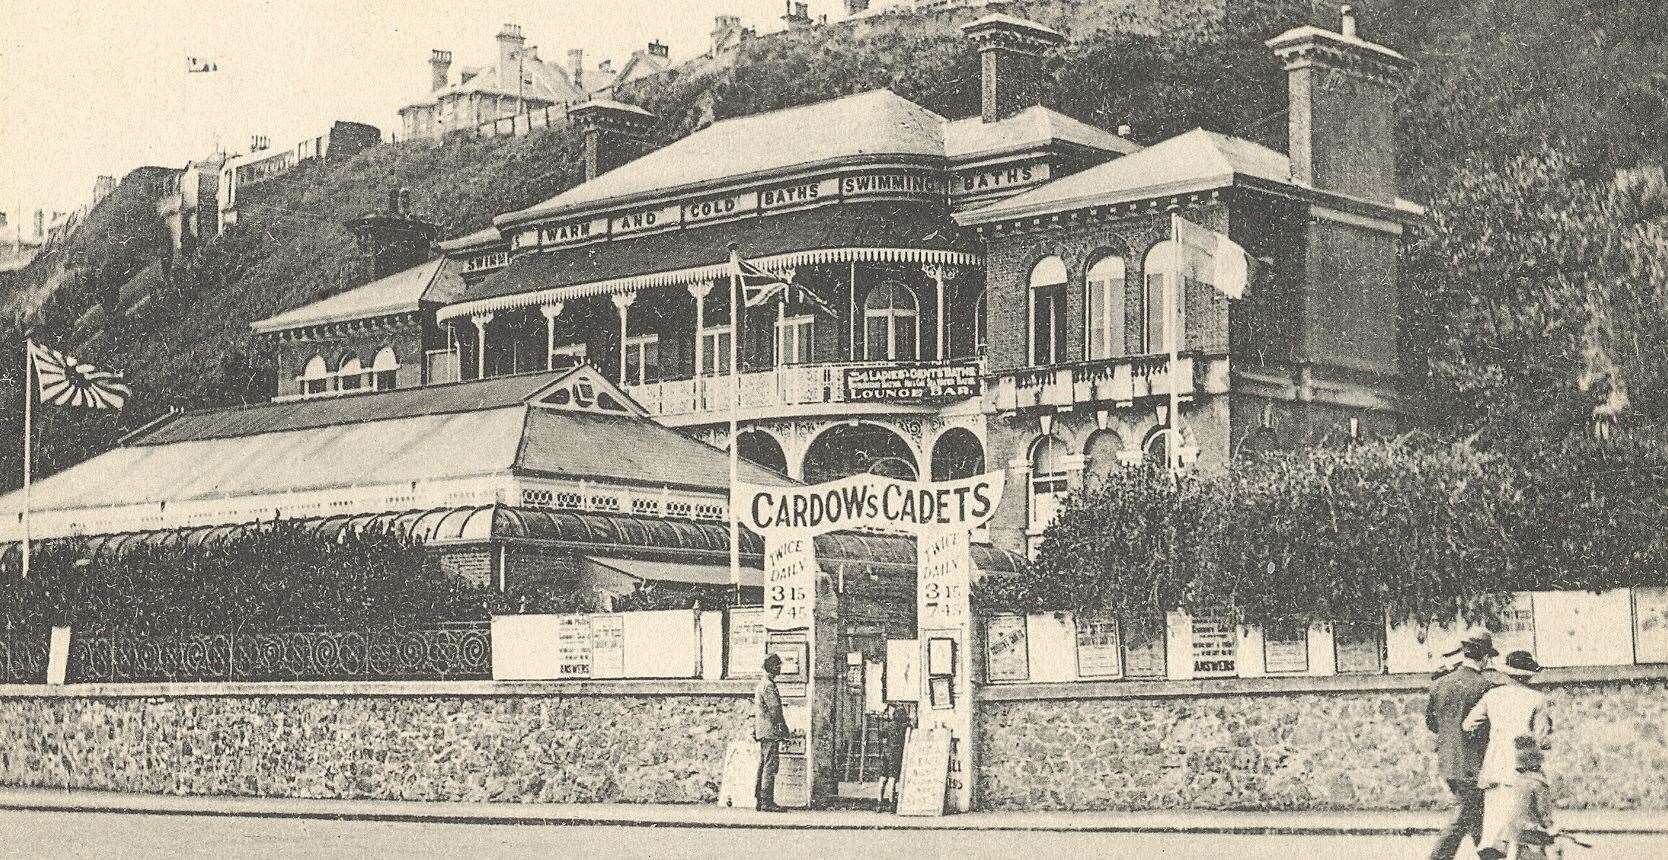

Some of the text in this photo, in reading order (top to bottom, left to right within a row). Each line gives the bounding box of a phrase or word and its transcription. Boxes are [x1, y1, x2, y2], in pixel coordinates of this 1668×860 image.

[963, 167, 1033, 192] BATHS
[548, 175, 937, 242] WARM AND COLD BATHS SWIMMING
[850, 388, 923, 399] LOUNGE
[882, 482, 991, 525] CADETS
[770, 539, 803, 567] TWICE
[770, 560, 804, 581] DAILY
[1194, 660, 1235, 672] ANSWERS
